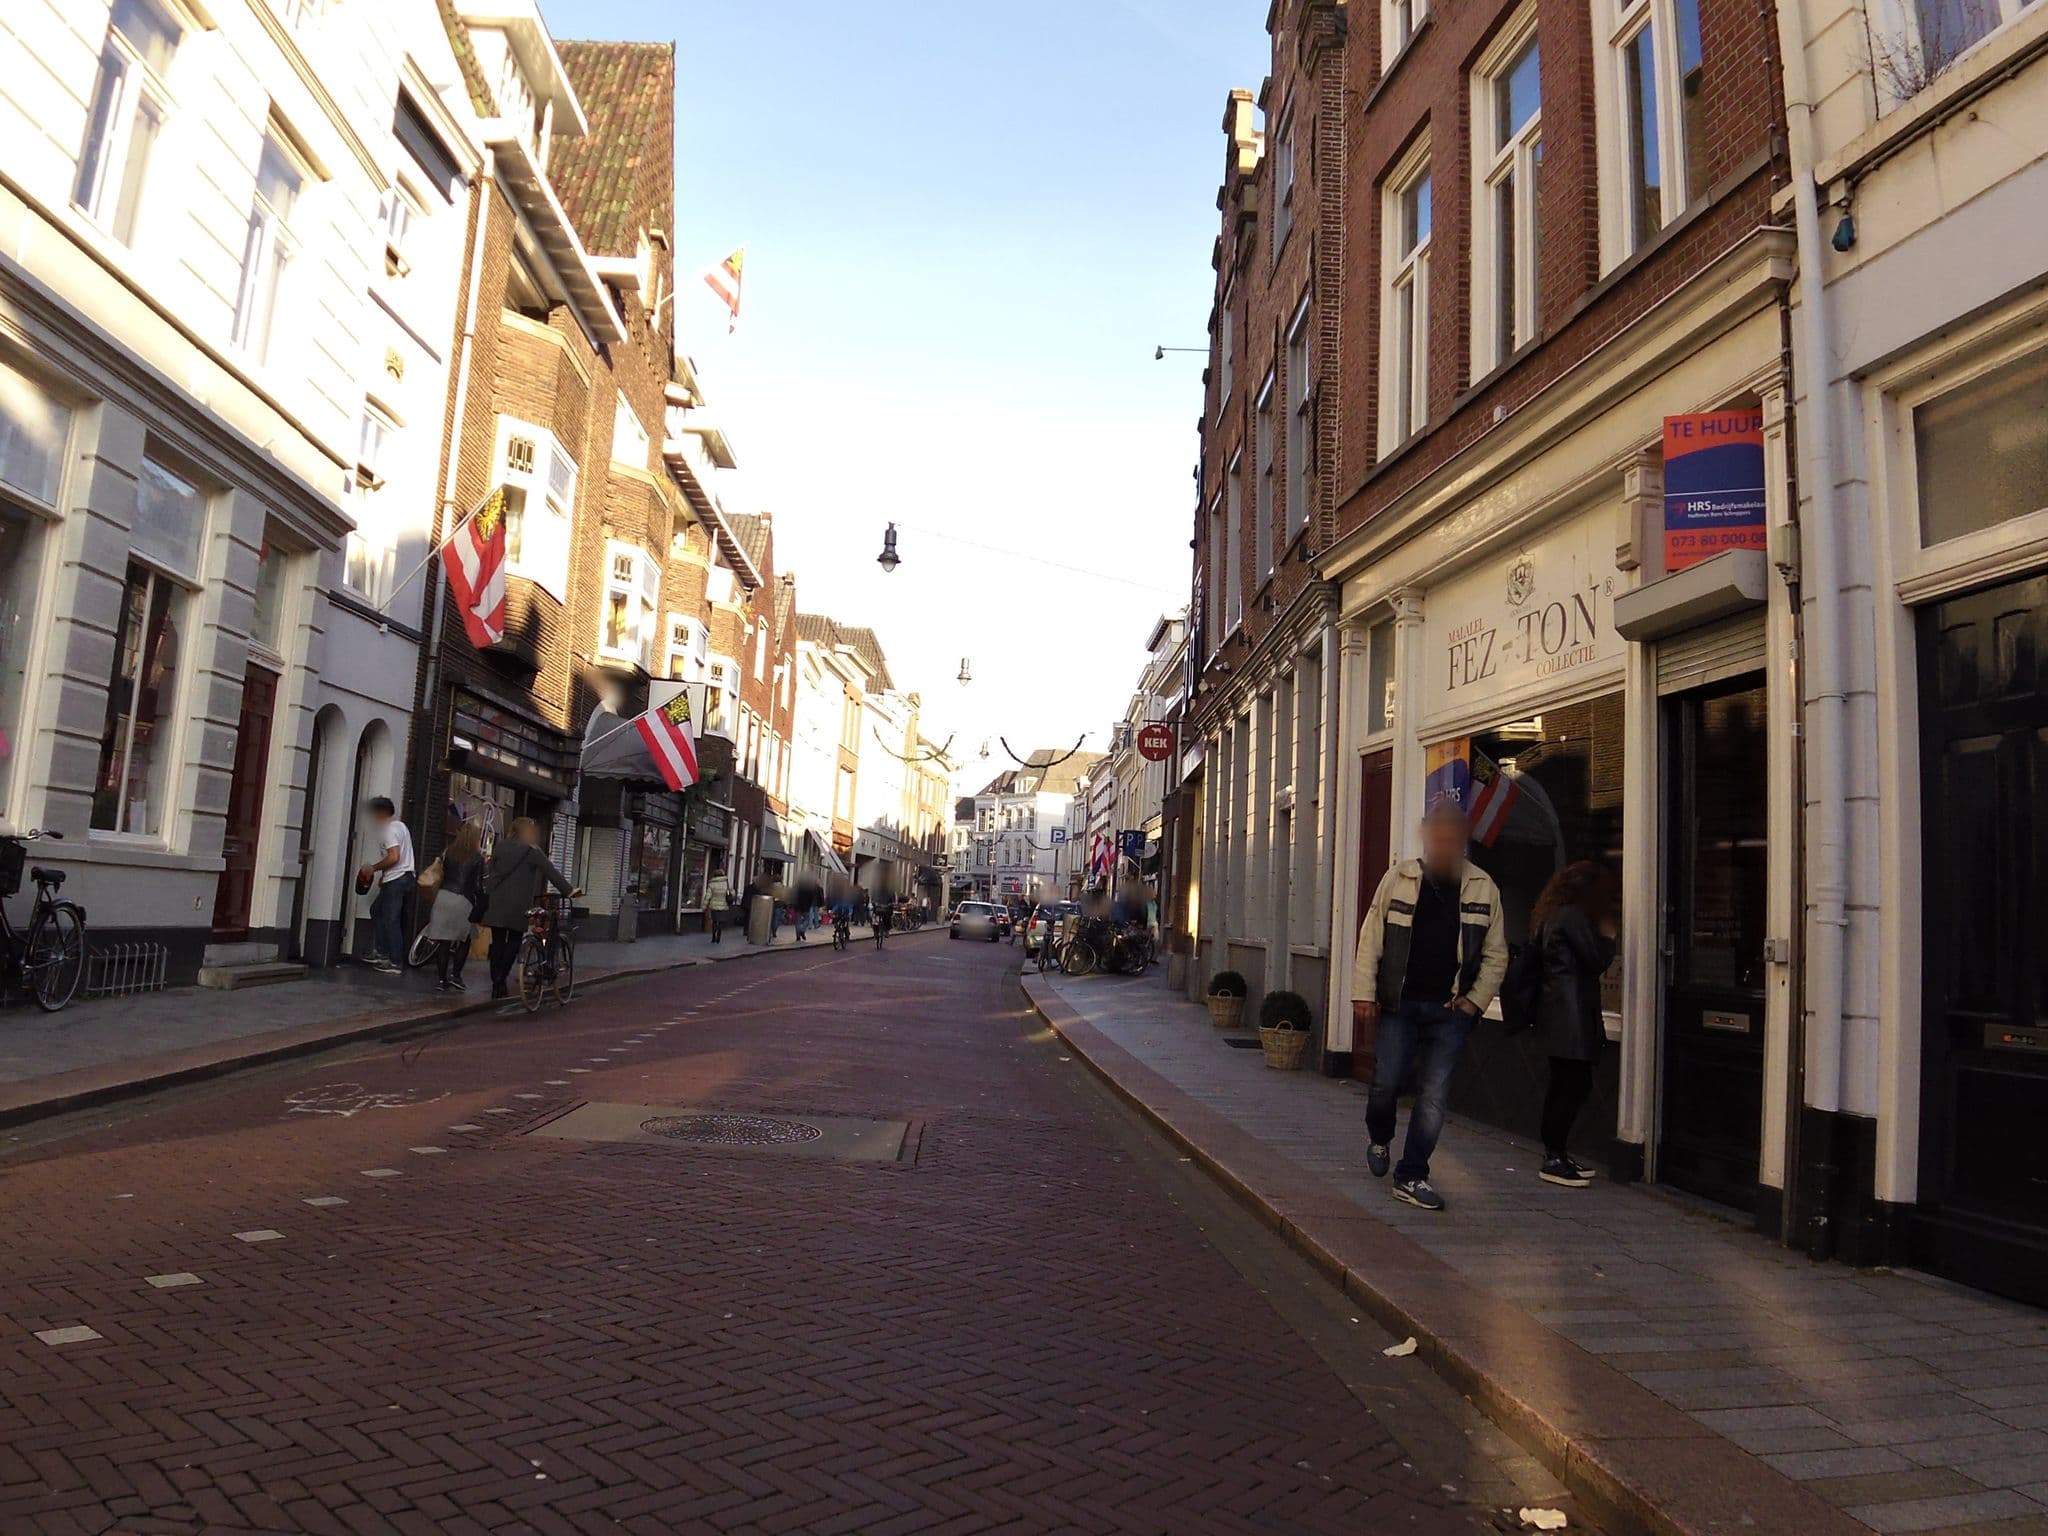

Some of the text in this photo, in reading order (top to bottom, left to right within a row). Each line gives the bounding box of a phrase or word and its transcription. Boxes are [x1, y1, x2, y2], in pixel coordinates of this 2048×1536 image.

[1670, 421, 1692, 438] TE
[1687, 501, 1711, 511] HRS
[1447, 584, 1600, 691] FEZ TON
[1536, 644, 1596, 678] COLLECTIE
[1144, 737, 1168, 749] KEK
[1053, 831, 1064, 842] P
[1126, 833, 1134, 846] P
